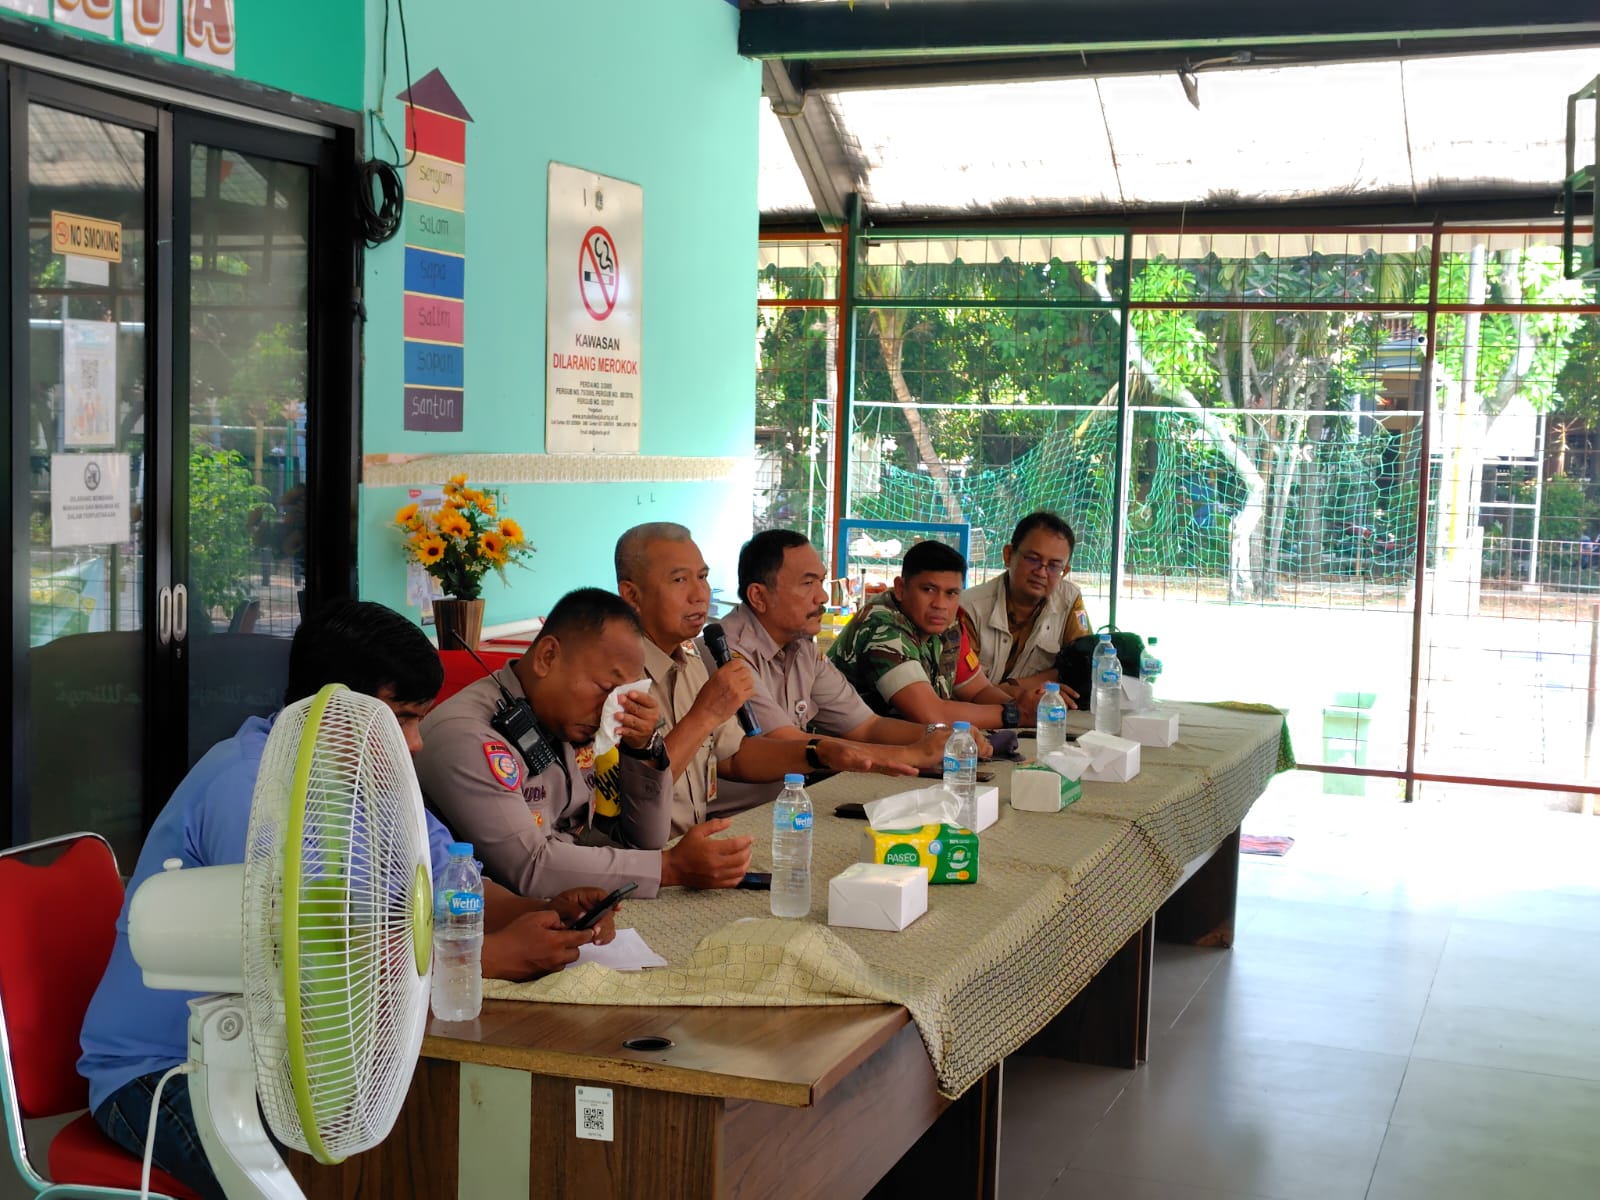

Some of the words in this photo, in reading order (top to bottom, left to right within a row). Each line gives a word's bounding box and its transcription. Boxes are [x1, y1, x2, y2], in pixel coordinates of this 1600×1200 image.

[419, 165, 453, 194] Senyum
[70, 224, 81, 247] NO
[84, 226, 119, 252] SMOKING
[575, 333, 620, 351] KAWASAN
[553, 352, 596, 371] DILARANG
[598, 357, 638, 375] MEROKOK
[411, 394, 454, 419] Santun
[887, 852, 917, 864] PASEO
